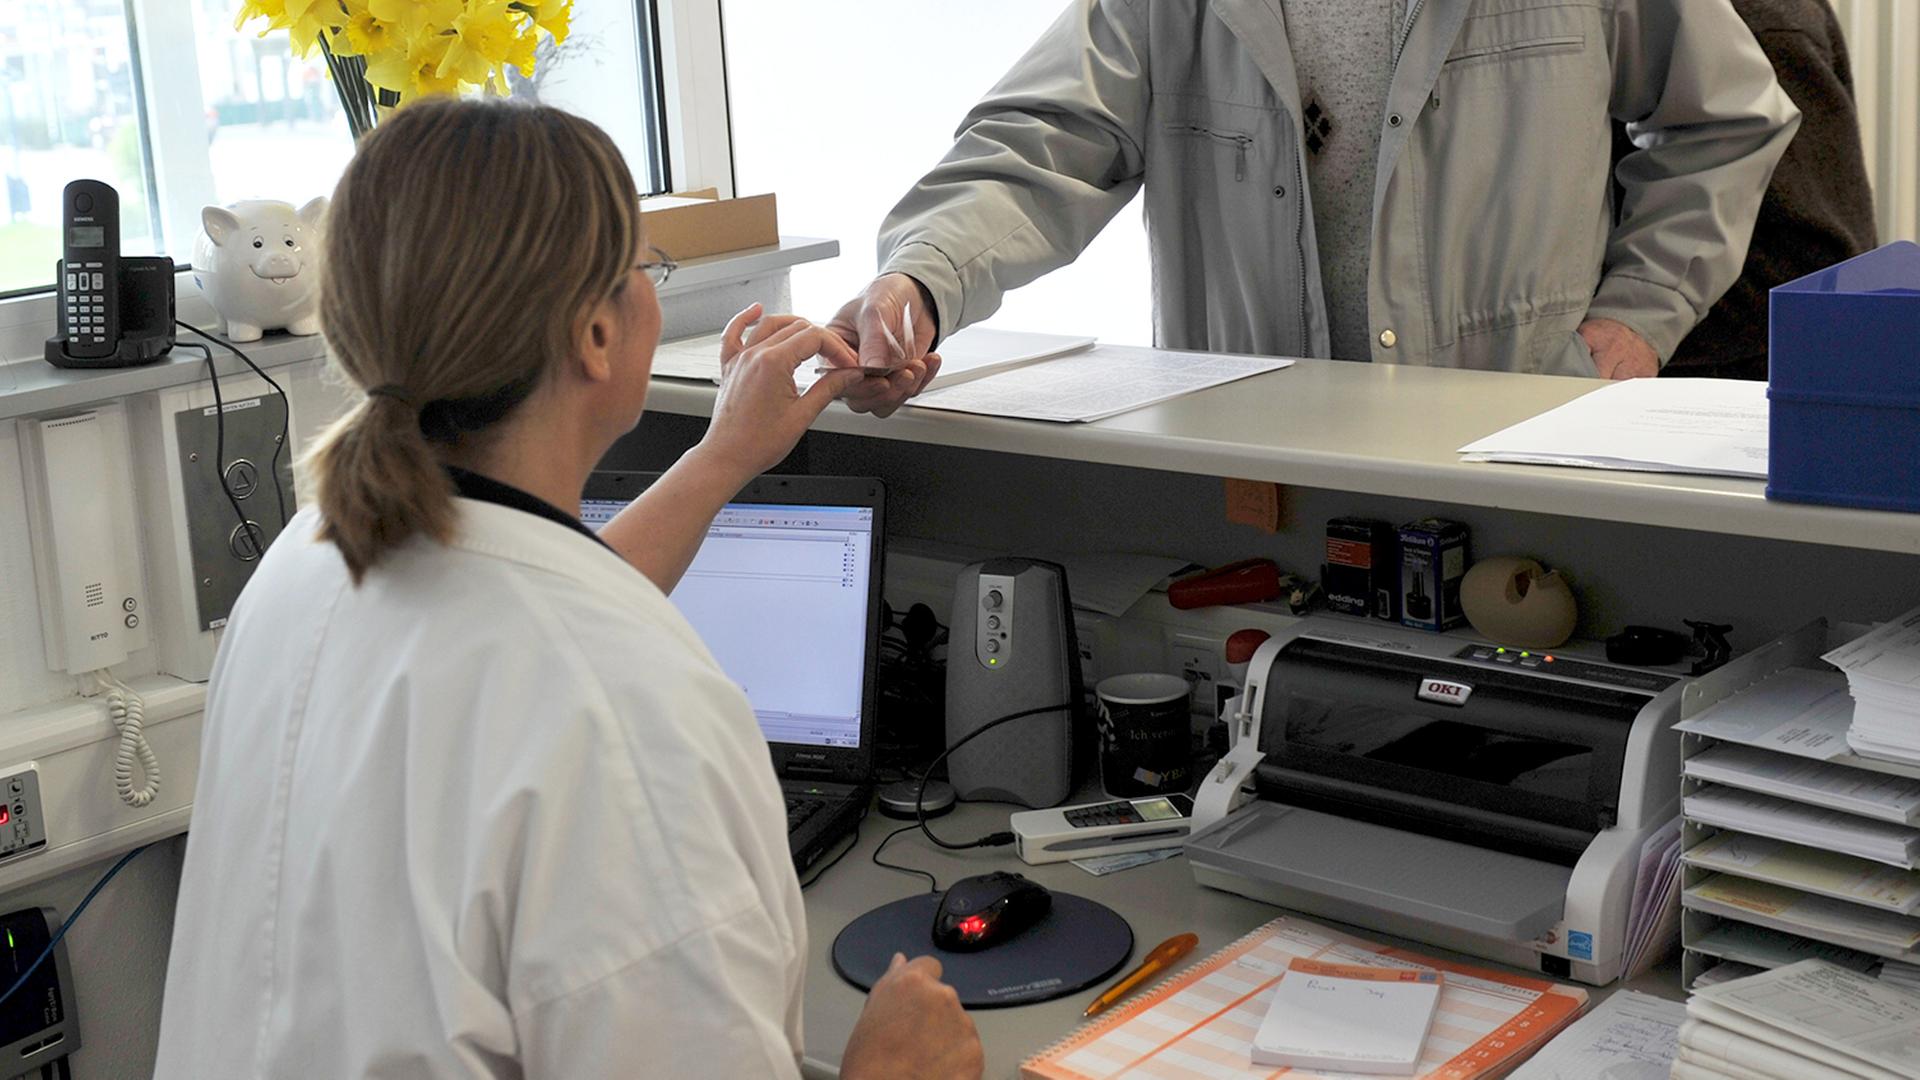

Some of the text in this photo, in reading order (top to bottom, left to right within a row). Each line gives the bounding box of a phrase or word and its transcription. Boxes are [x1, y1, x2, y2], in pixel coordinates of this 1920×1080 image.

[1328, 593, 1364, 607] edding
[90, 631, 109, 641] RITTO
[1428, 682, 1462, 696] OKI
[1488, 1040, 1505, 1049] 10
